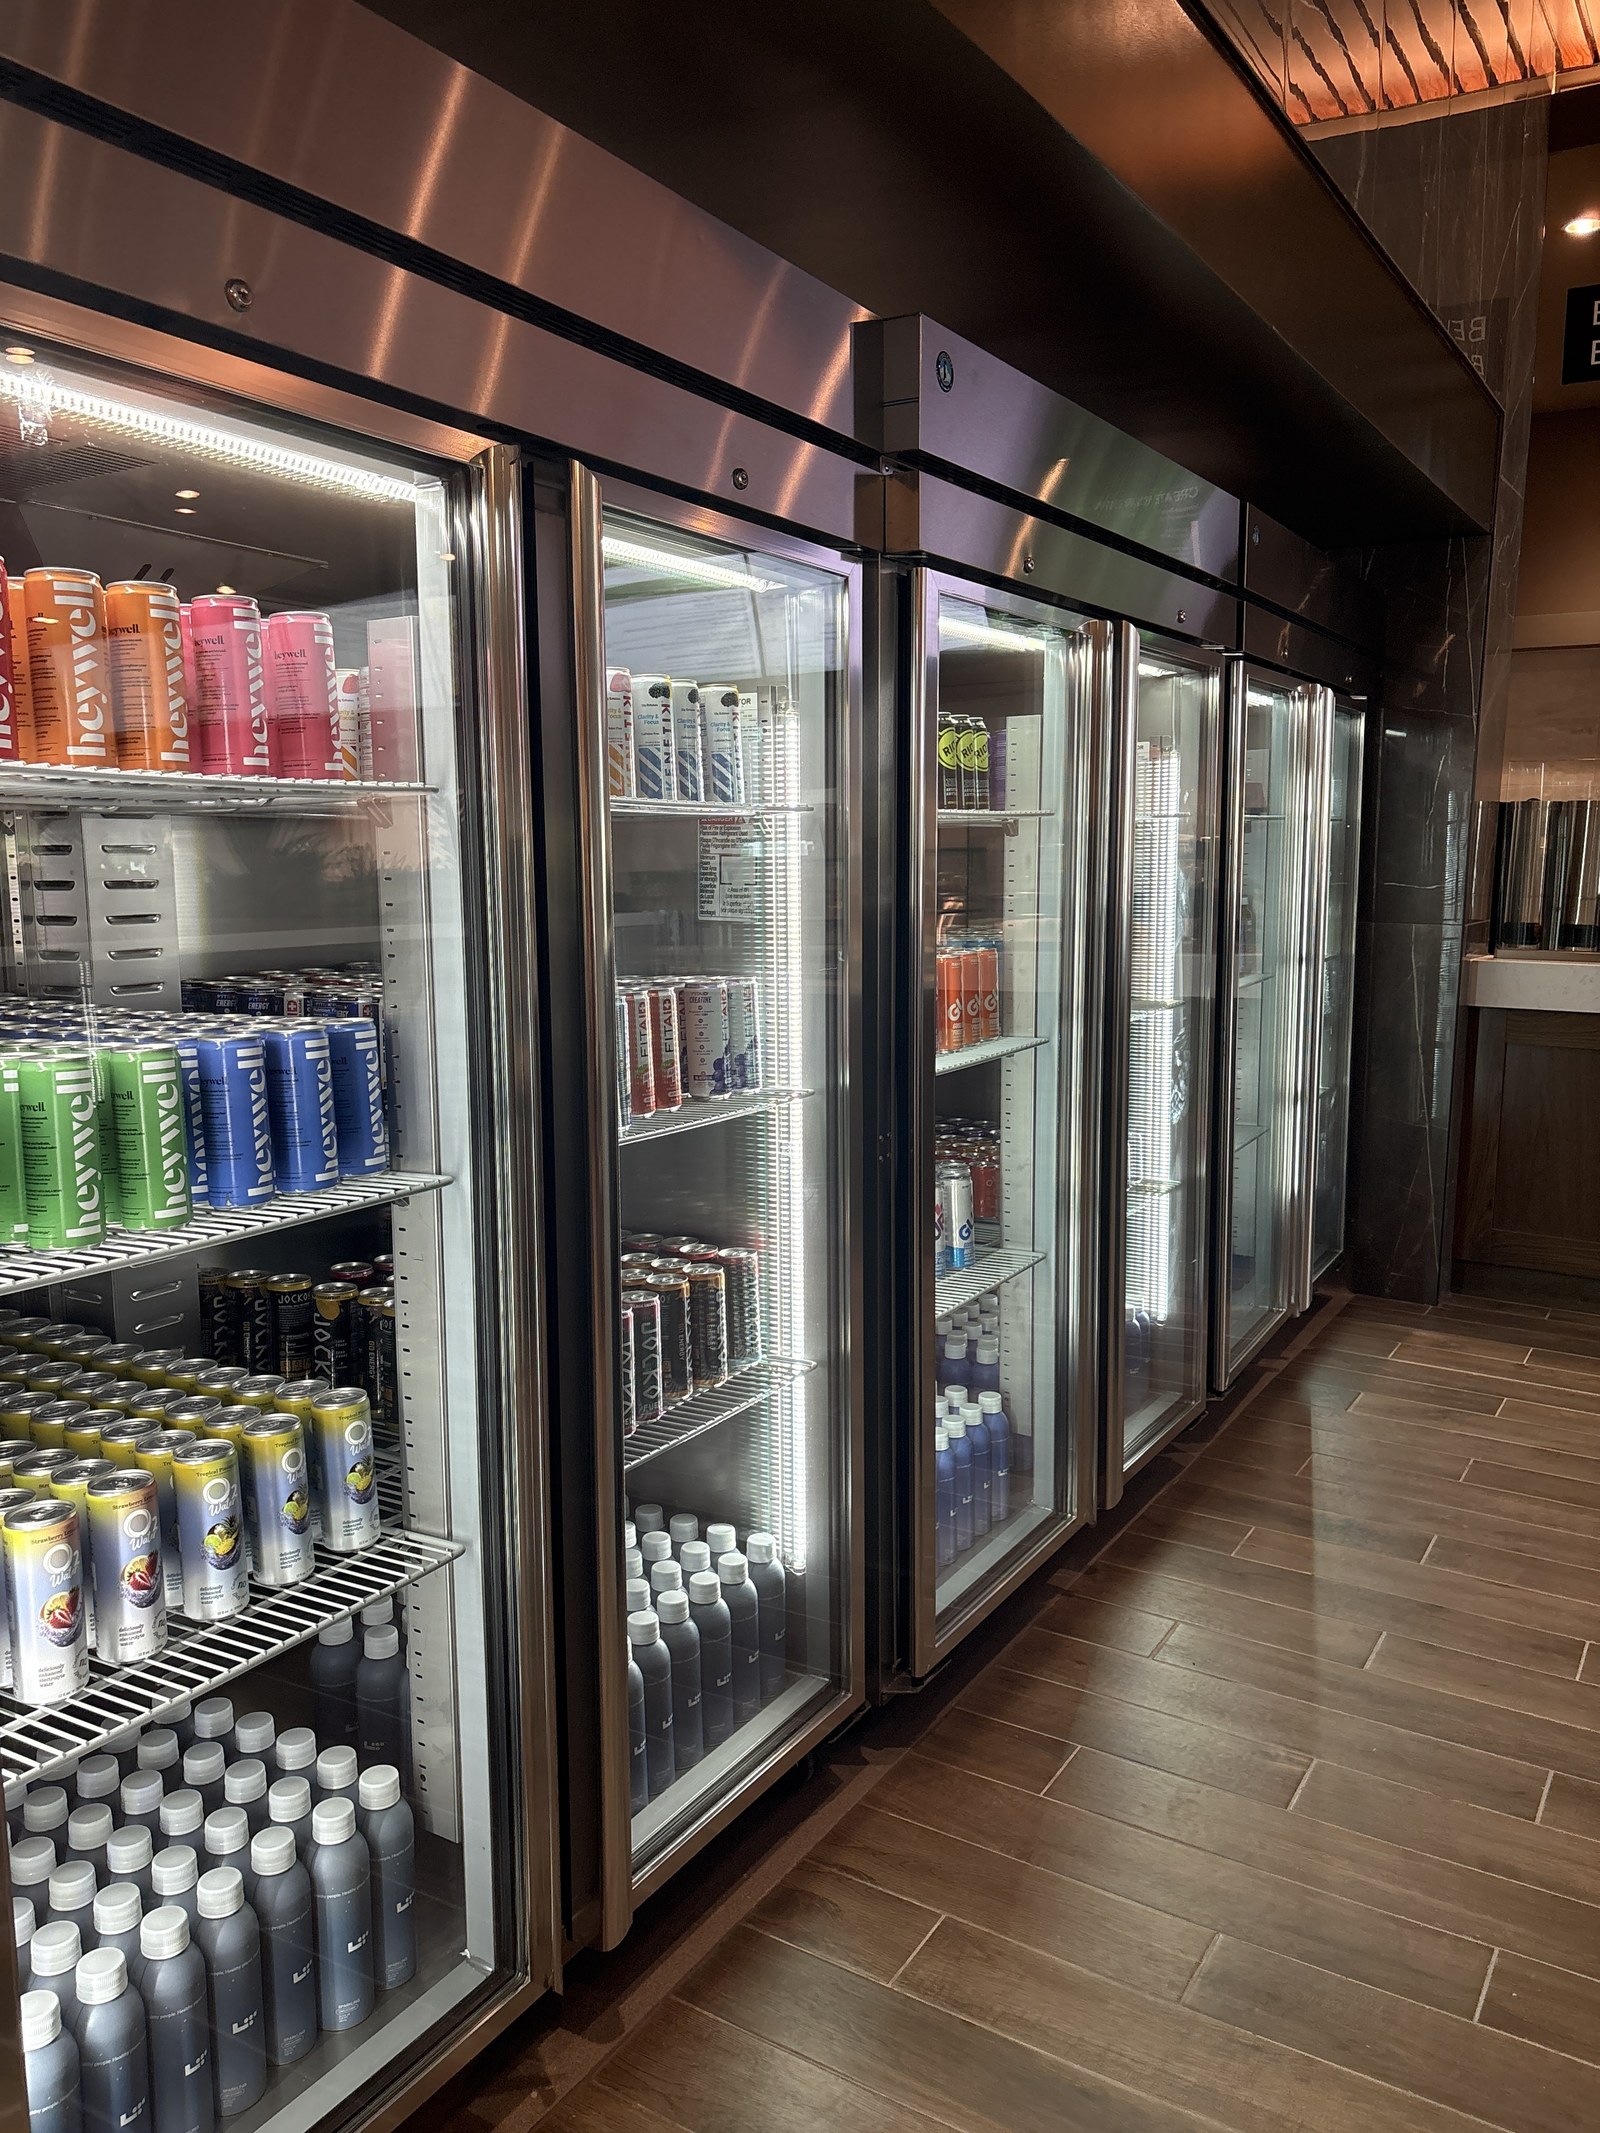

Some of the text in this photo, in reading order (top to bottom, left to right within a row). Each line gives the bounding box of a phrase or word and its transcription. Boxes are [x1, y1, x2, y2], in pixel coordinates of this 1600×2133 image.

[53, 581, 107, 756] heywell
[149, 595, 190, 762] heywell
[274, 649, 307, 660] heywell
[233, 608, 270, 767] heywell
[314, 623, 344, 771] heywell
[247, 1002, 270, 1010] ENERGY
[638, 1001, 648, 1058] FITAID
[663, 997, 674, 1054] FITAID
[237, 1046, 274, 1197] heywell
[305, 1038, 339, 1182] heywell
[355, 1029, 387, 1167] heywell
[54, 1069, 101, 1239] heywell
[142, 1059, 188, 1220] heywell
[278, 1292, 308, 1304] JOCKO
[641, 1321, 660, 1400] JOCKO
[197, 1467, 219, 1478] Tropical
[112, 1497, 143, 1511] Strawberry
[31, 1531, 64, 1546] Strawberry
[118, 1622, 145, 1634] deliciously
[119, 1640, 134, 1648] water
[38, 1661, 66, 1673] deliciously
[39, 1680, 54, 1688] water
